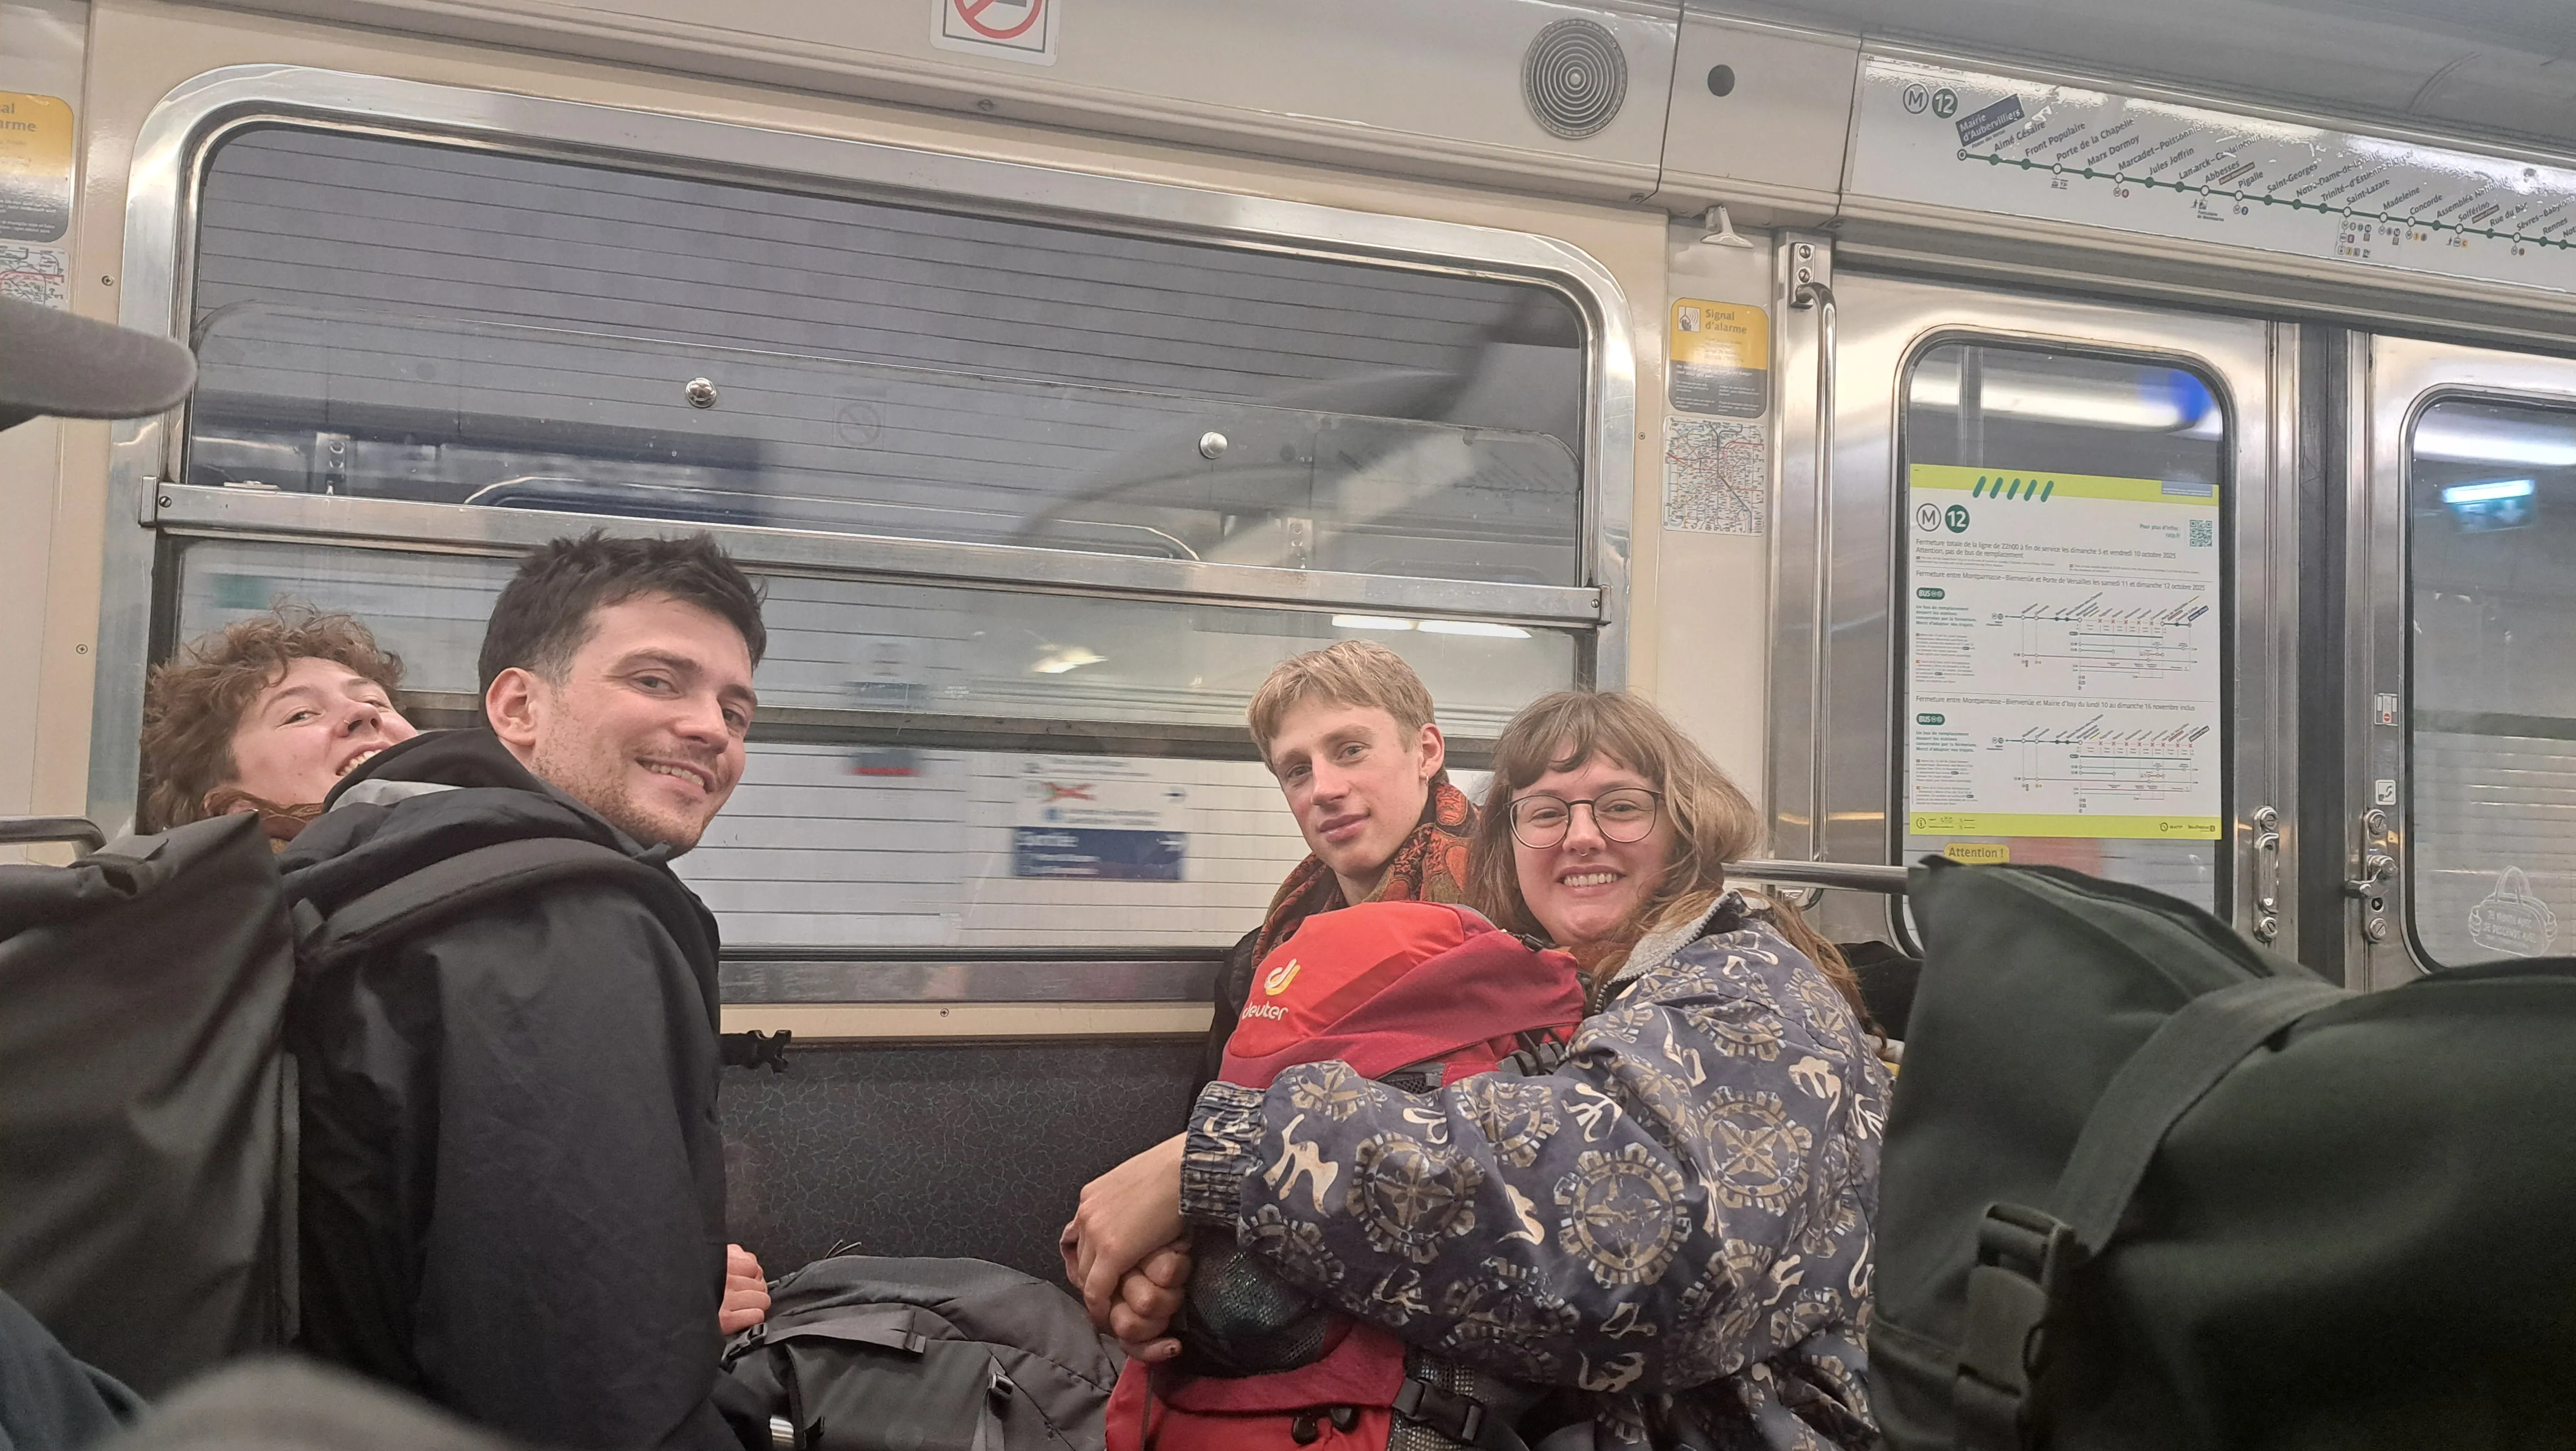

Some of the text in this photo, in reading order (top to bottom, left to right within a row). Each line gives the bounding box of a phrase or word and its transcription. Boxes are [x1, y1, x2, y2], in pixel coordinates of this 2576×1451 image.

[1935, 94, 1954, 114] 12
[1959, 114, 1987, 133] Mairie
[1963, 109, 2021, 142] d'Aubervilliers
[1994, 133, 2015, 152] Aimé
[2016, 121, 2046, 140] Césaire
[2025, 122, 2086, 157] Front Populaire
[2056, 118, 2135, 162] Porte de la Chapelle
[2087, 135, 2140, 166] Marx Dormoy
[2149, 147, 2194, 176] Jules Joffrin
[2205, 160, 2240, 183] Abbesses
[2238, 171, 2264, 188] Pigalle
[2267, 163, 2318, 193] Saint-Georges
[2346, 178, 2390, 205] Saint-Lazare
[2383, 187, 2420, 210] Madeleine
[2409, 194, 2443, 215] Concorde
[2437, 194, 2473, 218] Assemblée
[2457, 201, 2490, 222] Solférino
[2490, 215, 2504, 226] Rue
[2505, 209, 2515, 219] du
[2542, 217, 2568, 235] Rennes
[1705, 309, 1735, 320] Signal
[1705, 321, 1747, 334] d'alarme
[1922, 509, 1967, 528] M 12
[2061, 700, 2076, 709] d'Issy
[1949, 847, 2004, 858] Attention !
[1241, 1000, 1289, 1021] deuter
